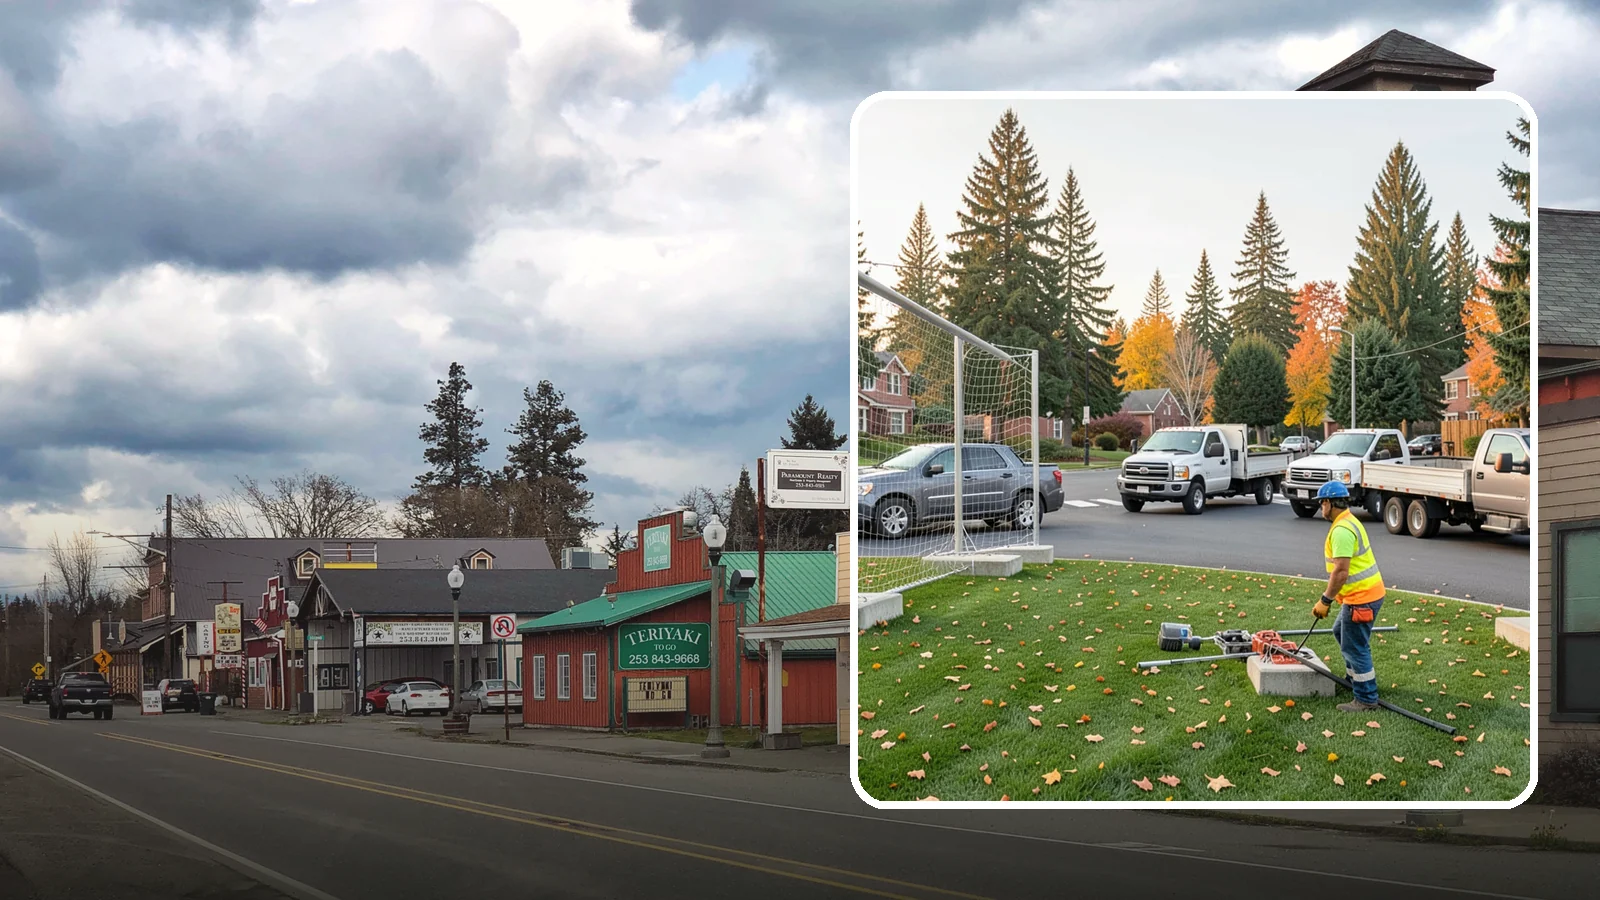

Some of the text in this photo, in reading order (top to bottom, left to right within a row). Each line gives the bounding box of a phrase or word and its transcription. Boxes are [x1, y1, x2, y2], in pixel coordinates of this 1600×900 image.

[625, 627, 702, 646] TERIYAKI
[628, 653, 700, 664] 253 843-9668
[639, 681, 673, 691] TERIYAKI
